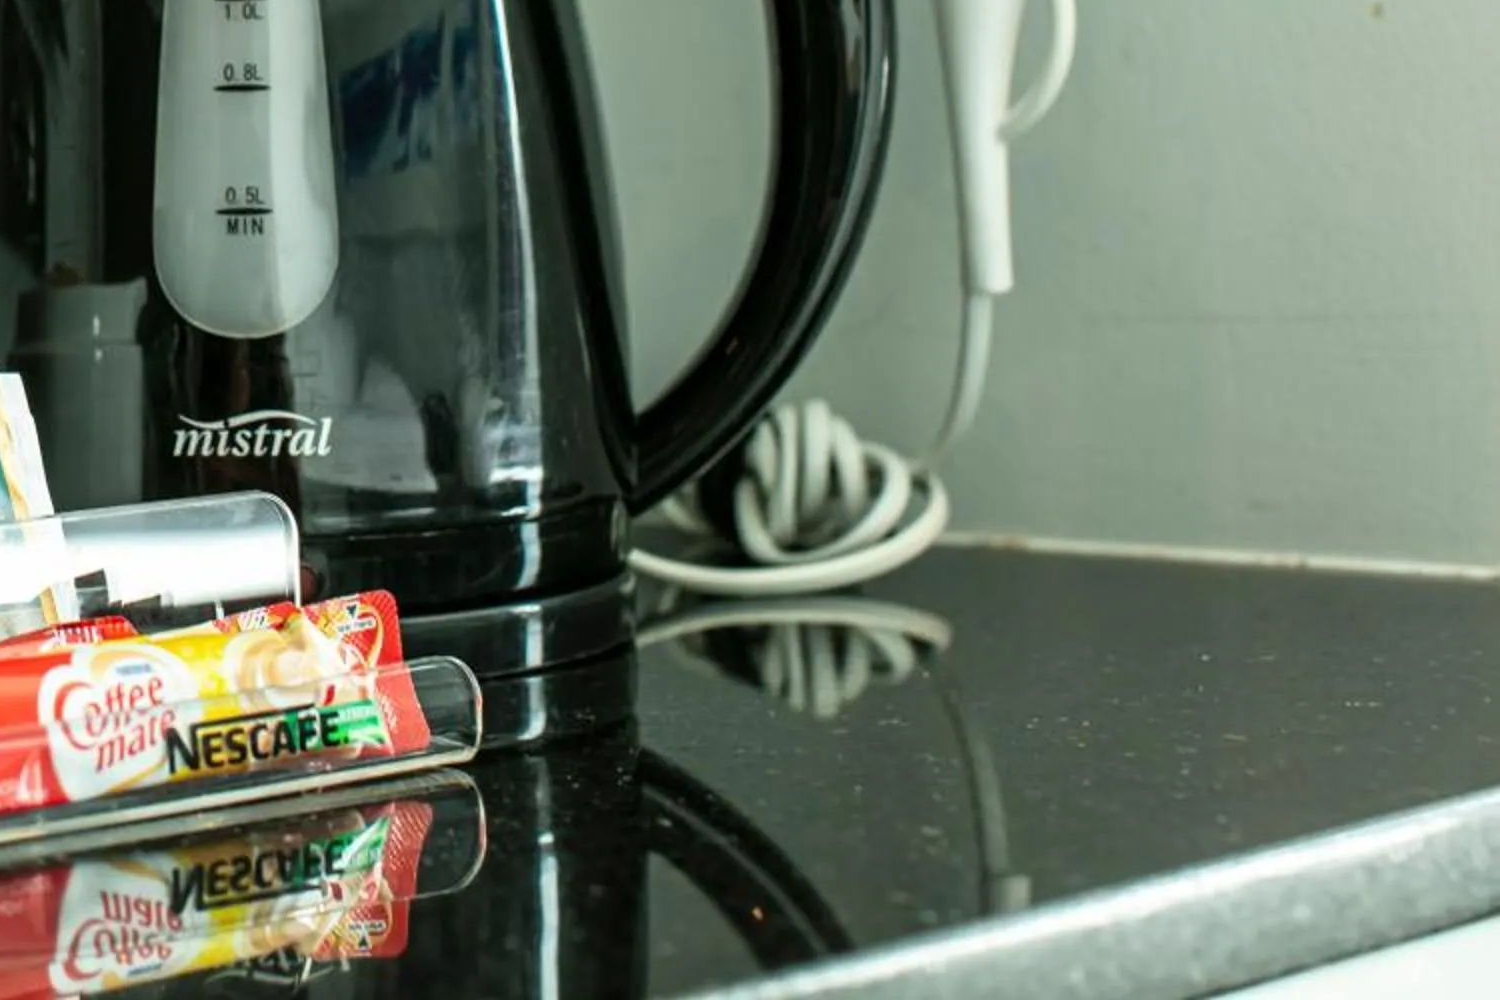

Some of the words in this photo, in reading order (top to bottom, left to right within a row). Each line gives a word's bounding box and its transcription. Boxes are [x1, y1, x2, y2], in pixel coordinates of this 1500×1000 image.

[224, 2, 264, 21] 1.0L
[222, 62, 264, 82] 0.8L
[225, 187, 265, 205] 0.5L
[226, 218, 265, 236] MIN
[172, 411, 333, 457] mistral
[96, 709, 176, 774] mate
